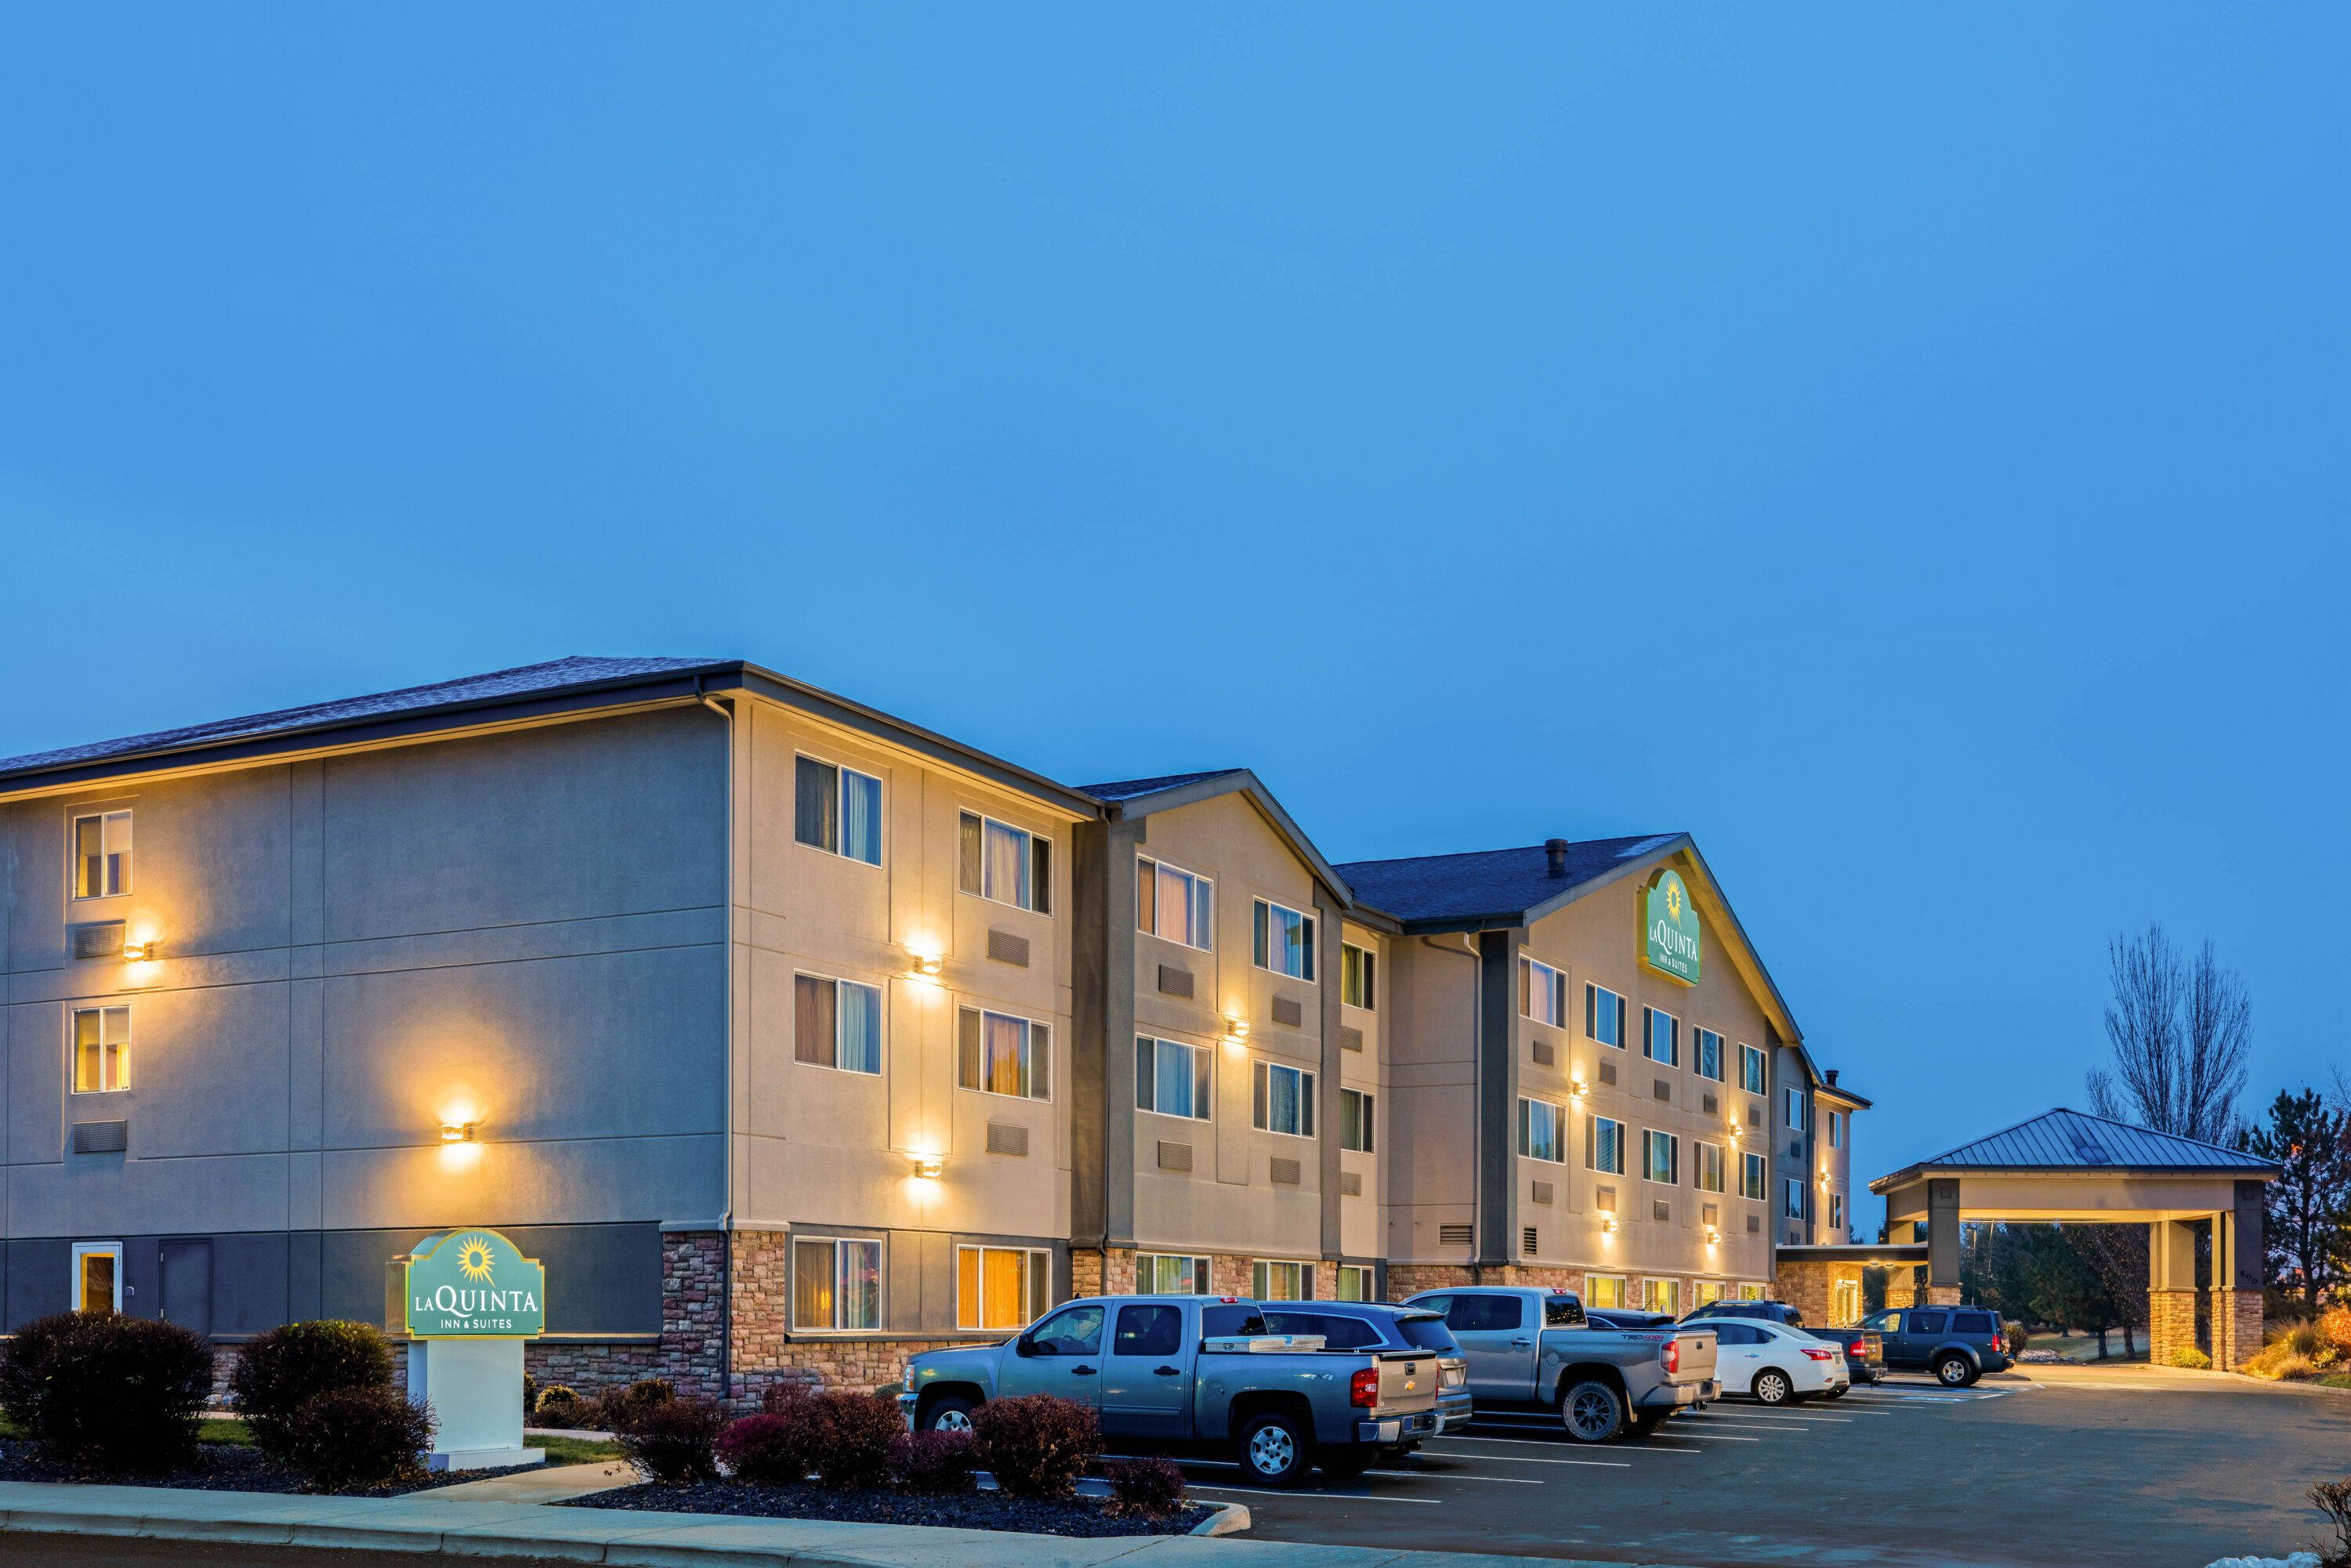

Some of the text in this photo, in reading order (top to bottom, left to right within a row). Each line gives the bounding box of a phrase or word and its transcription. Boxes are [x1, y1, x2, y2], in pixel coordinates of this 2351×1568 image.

[1650, 919, 1697, 961] LA QUINTA
[1659, 952, 1668, 965] INN
[1672, 958, 1687, 973] SUITES
[415, 1285, 538, 1318] LA QUINTA
[440, 1319, 512, 1329] INN & SUITES
